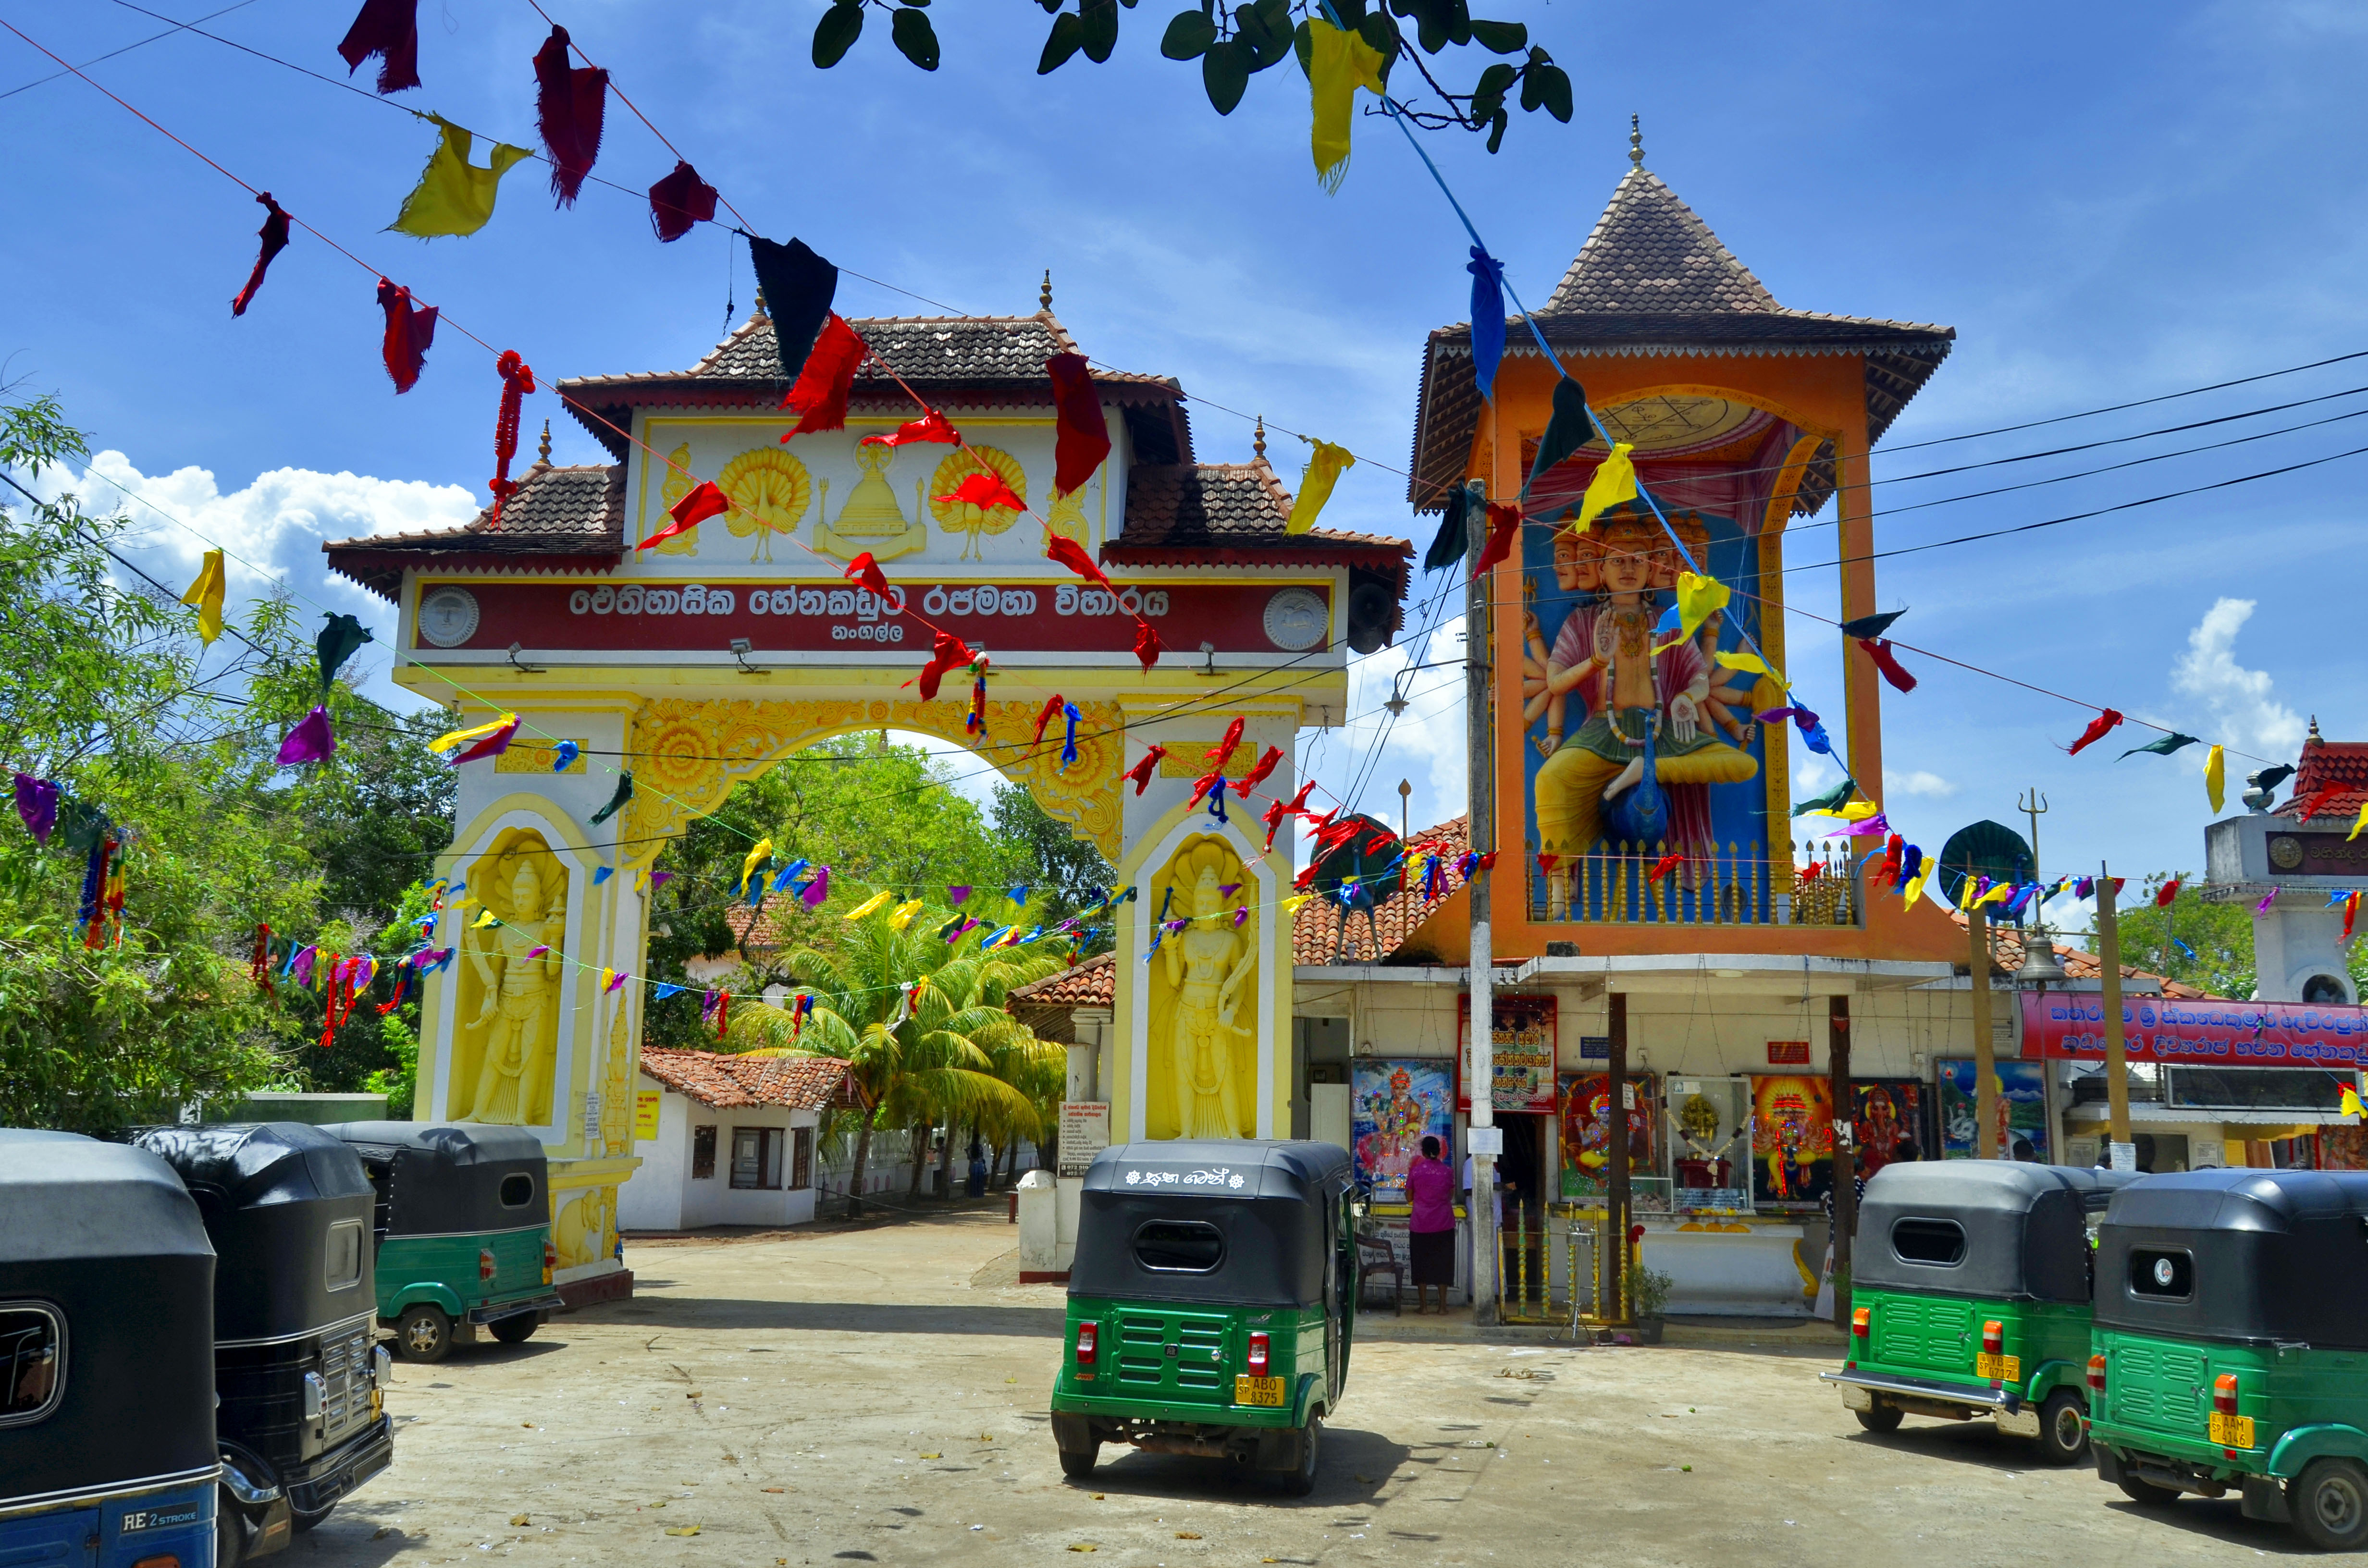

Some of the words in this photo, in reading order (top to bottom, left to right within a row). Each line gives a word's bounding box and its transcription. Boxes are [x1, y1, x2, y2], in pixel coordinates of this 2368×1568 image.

[924, 585, 1036, 615] රජමහා
[1056, 584, 1169, 616] විහාරය
[832, 623, 903, 642] තංගල්ල
[1991, 1356, 2003, 1366] YB
[1989, 1367, 2012, 1378] 0717
[1253, 1378, 1276, 1390] ABO
[1251, 1392, 1277, 1404] 8375
[2212, 1423, 2221, 1432] SP
[2223, 1417, 2244, 1431] AAM
[2222, 1432, 2245, 1446] 4146
[123, 1513, 146, 1531] RE
[149, 1514, 158, 1526] 2
[159, 1512, 196, 1525] STROKE
